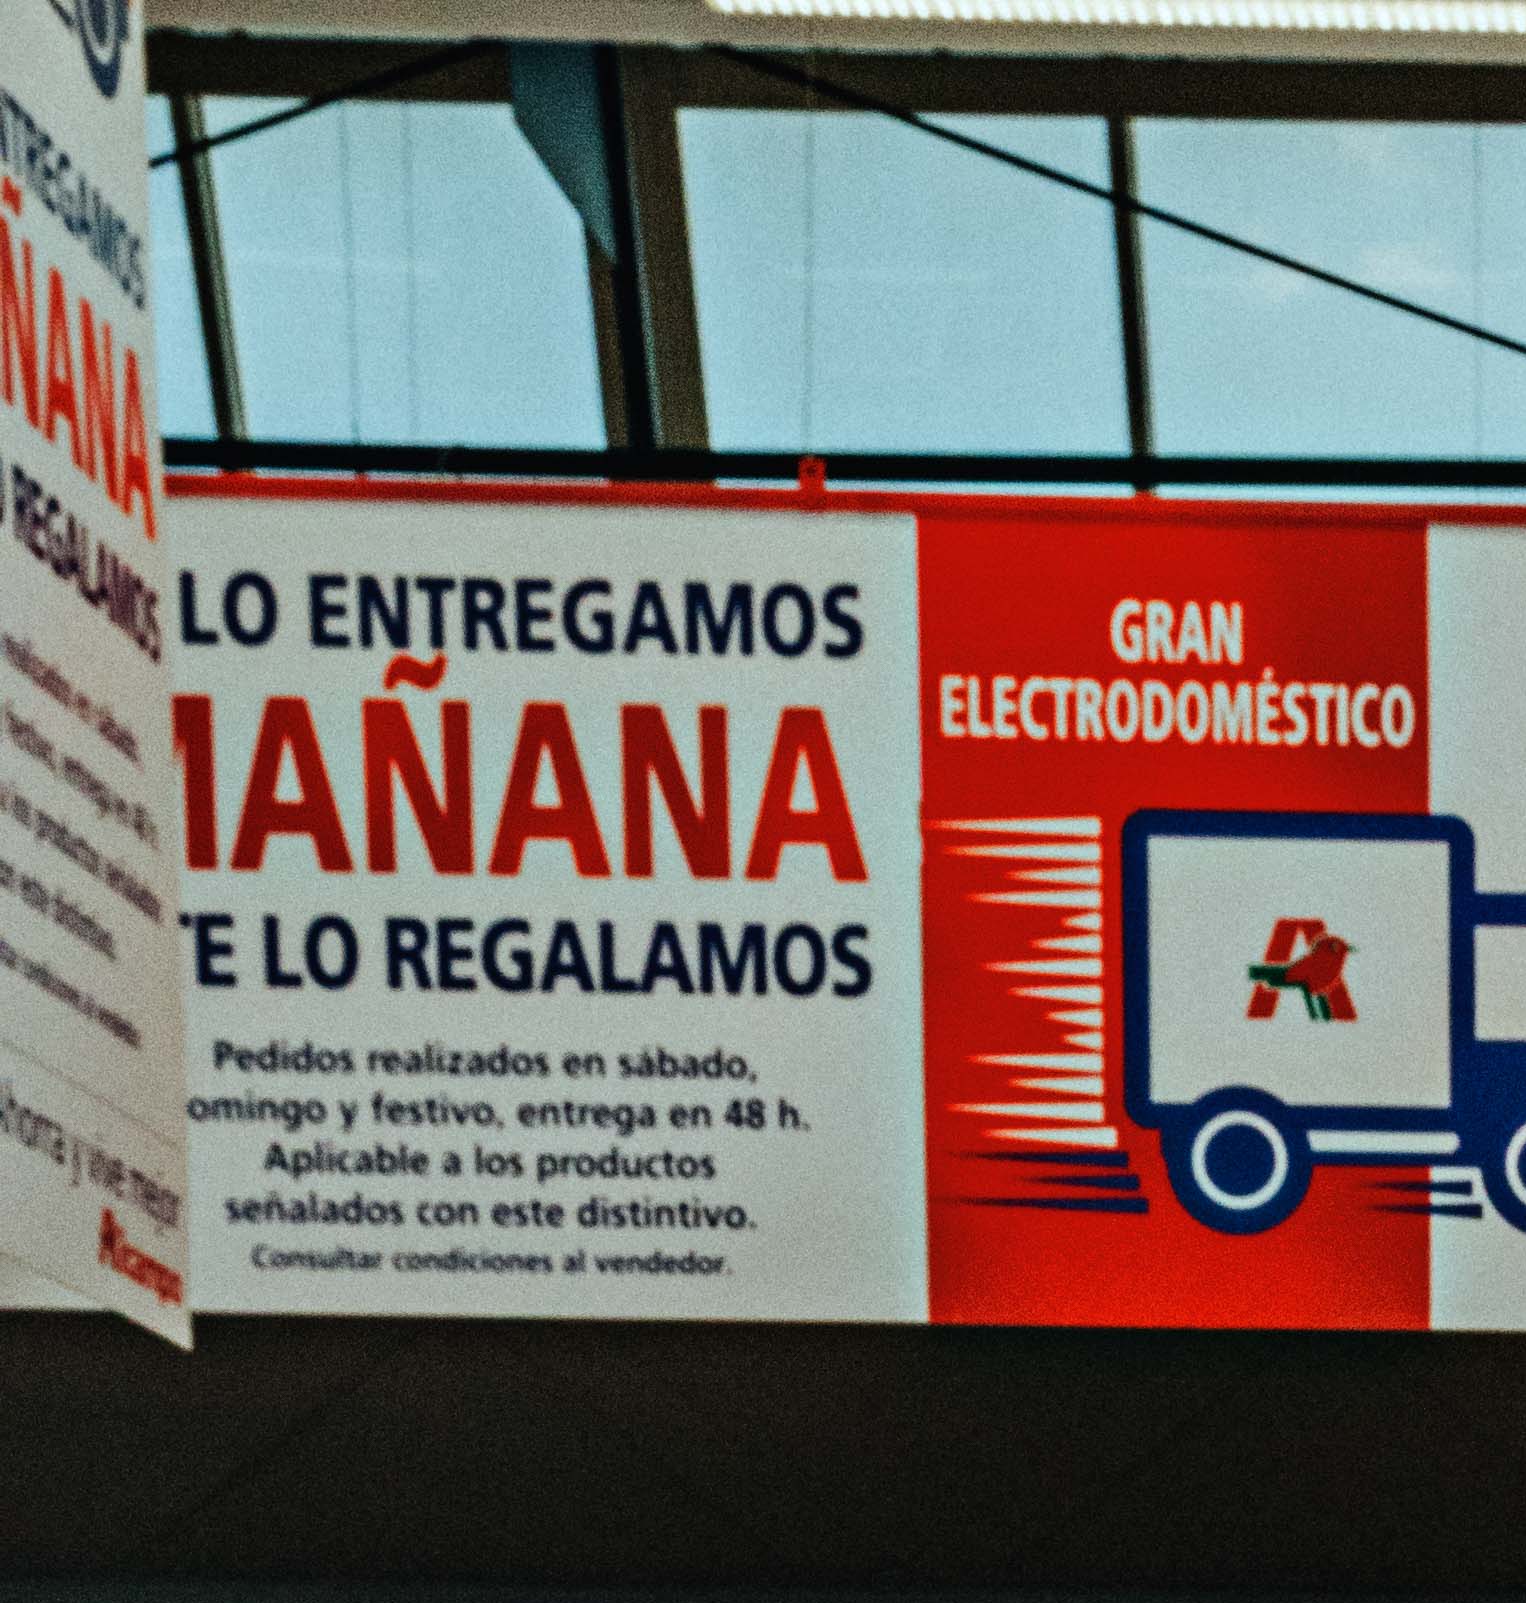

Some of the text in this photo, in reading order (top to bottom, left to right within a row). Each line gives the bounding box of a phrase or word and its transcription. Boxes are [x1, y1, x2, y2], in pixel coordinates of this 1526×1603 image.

[0, 176, 156, 543] ÑANA
[178, 571, 864, 660] LO ENTREGAMOS
[1110, 599, 1242, 666] GRAN
[939, 668, 1416, 748] ELECTRODOMÉSTICO
[180, 911, 236, 990] E
[264, 914, 360, 991] LO
[388, 918, 873, 999] REGALAMOS
[212, 1041, 758, 1084] Pedidos realizados en sábado,
[187, 1093, 811, 1137] omingo y festivo, entrega en 48 h.
[264, 1143, 715, 1185] Aplicable a los productos
[225, 1192, 756, 1231] señalados con este distintivo.
